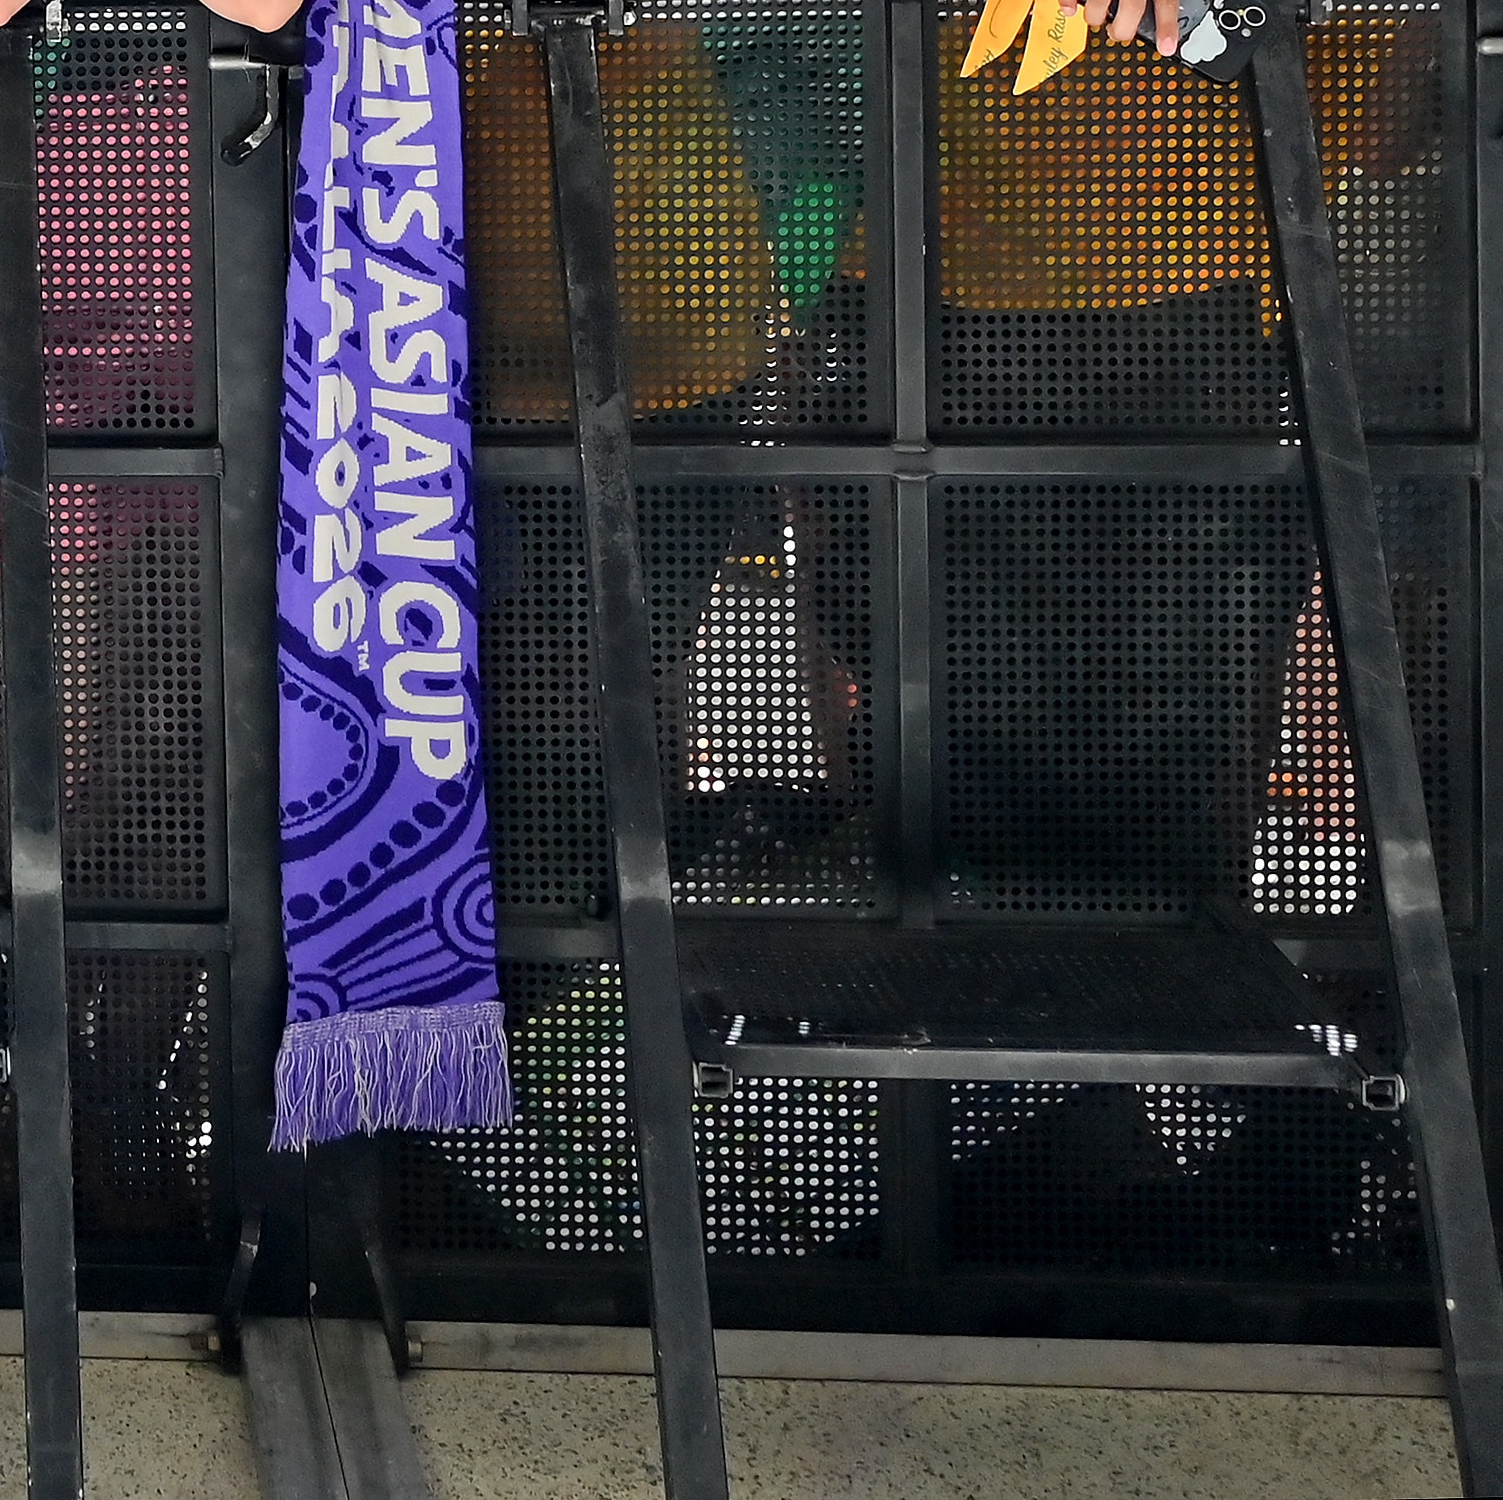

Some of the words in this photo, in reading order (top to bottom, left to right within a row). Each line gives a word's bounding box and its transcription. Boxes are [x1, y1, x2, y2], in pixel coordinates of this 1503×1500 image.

[312, 370, 367, 653] 2026
[365, 257, 456, 561] ASIAN
[379, 580, 468, 781] CUP
